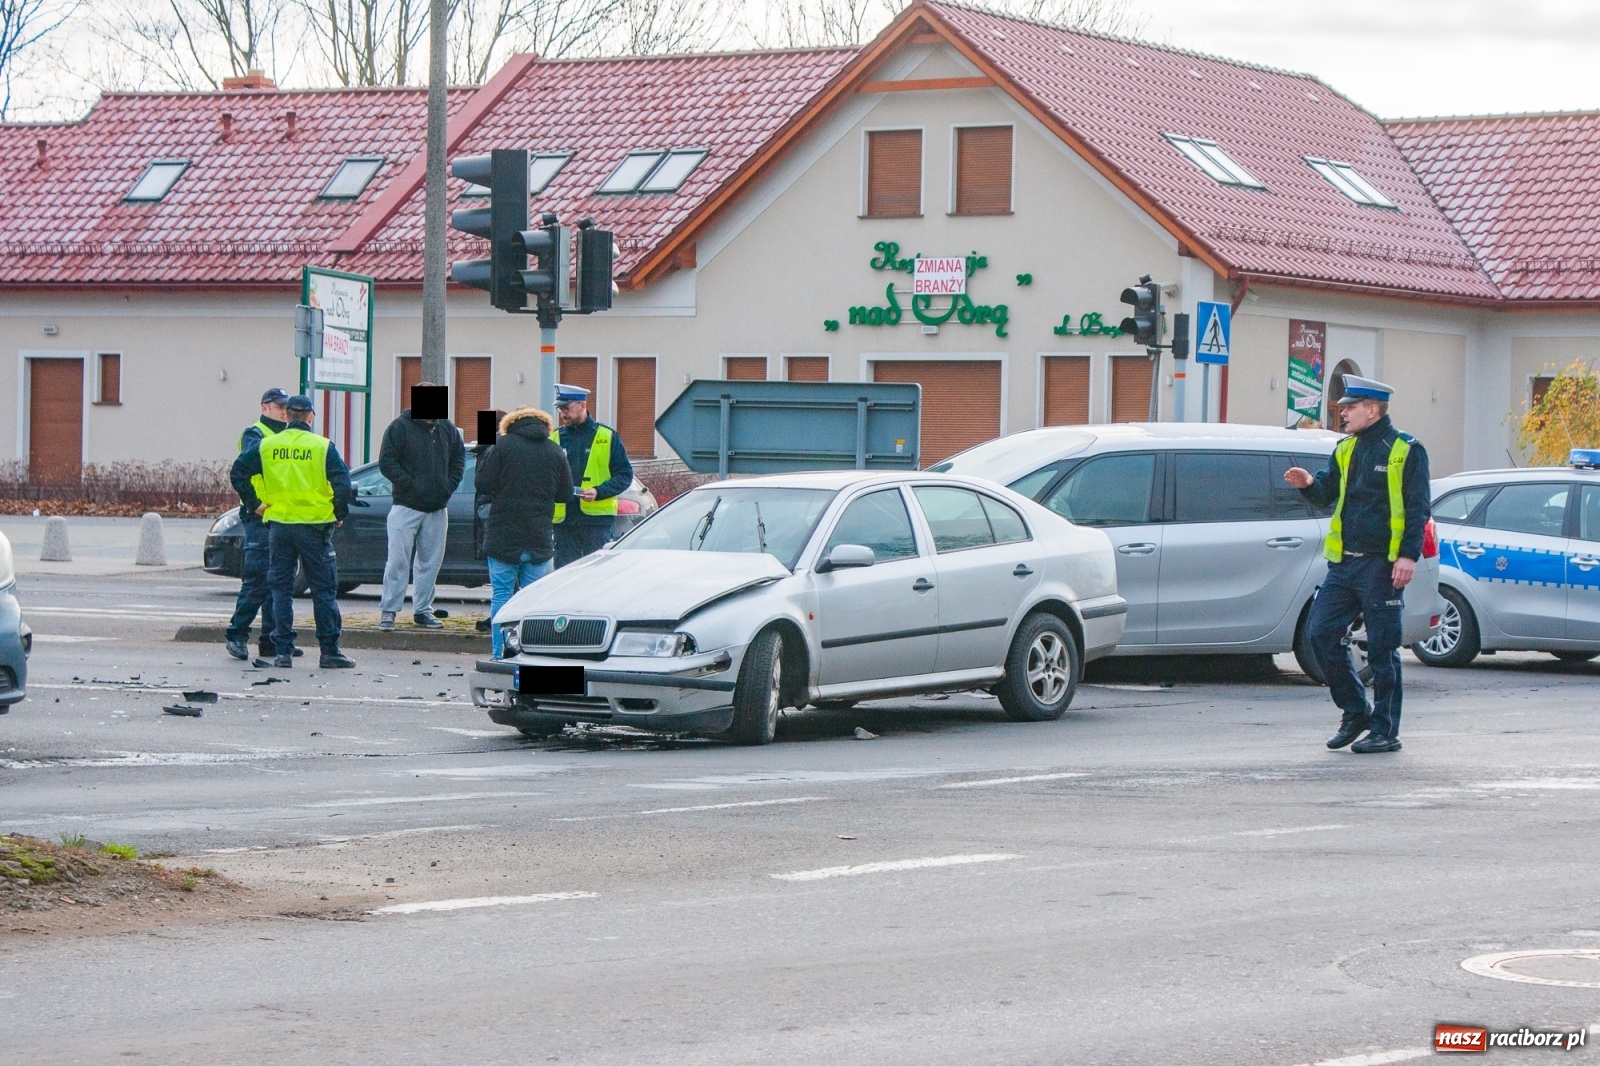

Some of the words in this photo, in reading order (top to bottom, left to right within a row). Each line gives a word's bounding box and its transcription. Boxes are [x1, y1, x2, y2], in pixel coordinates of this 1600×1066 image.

[917, 259, 963, 274] ZMIANA
[915, 276, 964, 293] BRANŻY
[272, 448, 312, 461] POLICJA
